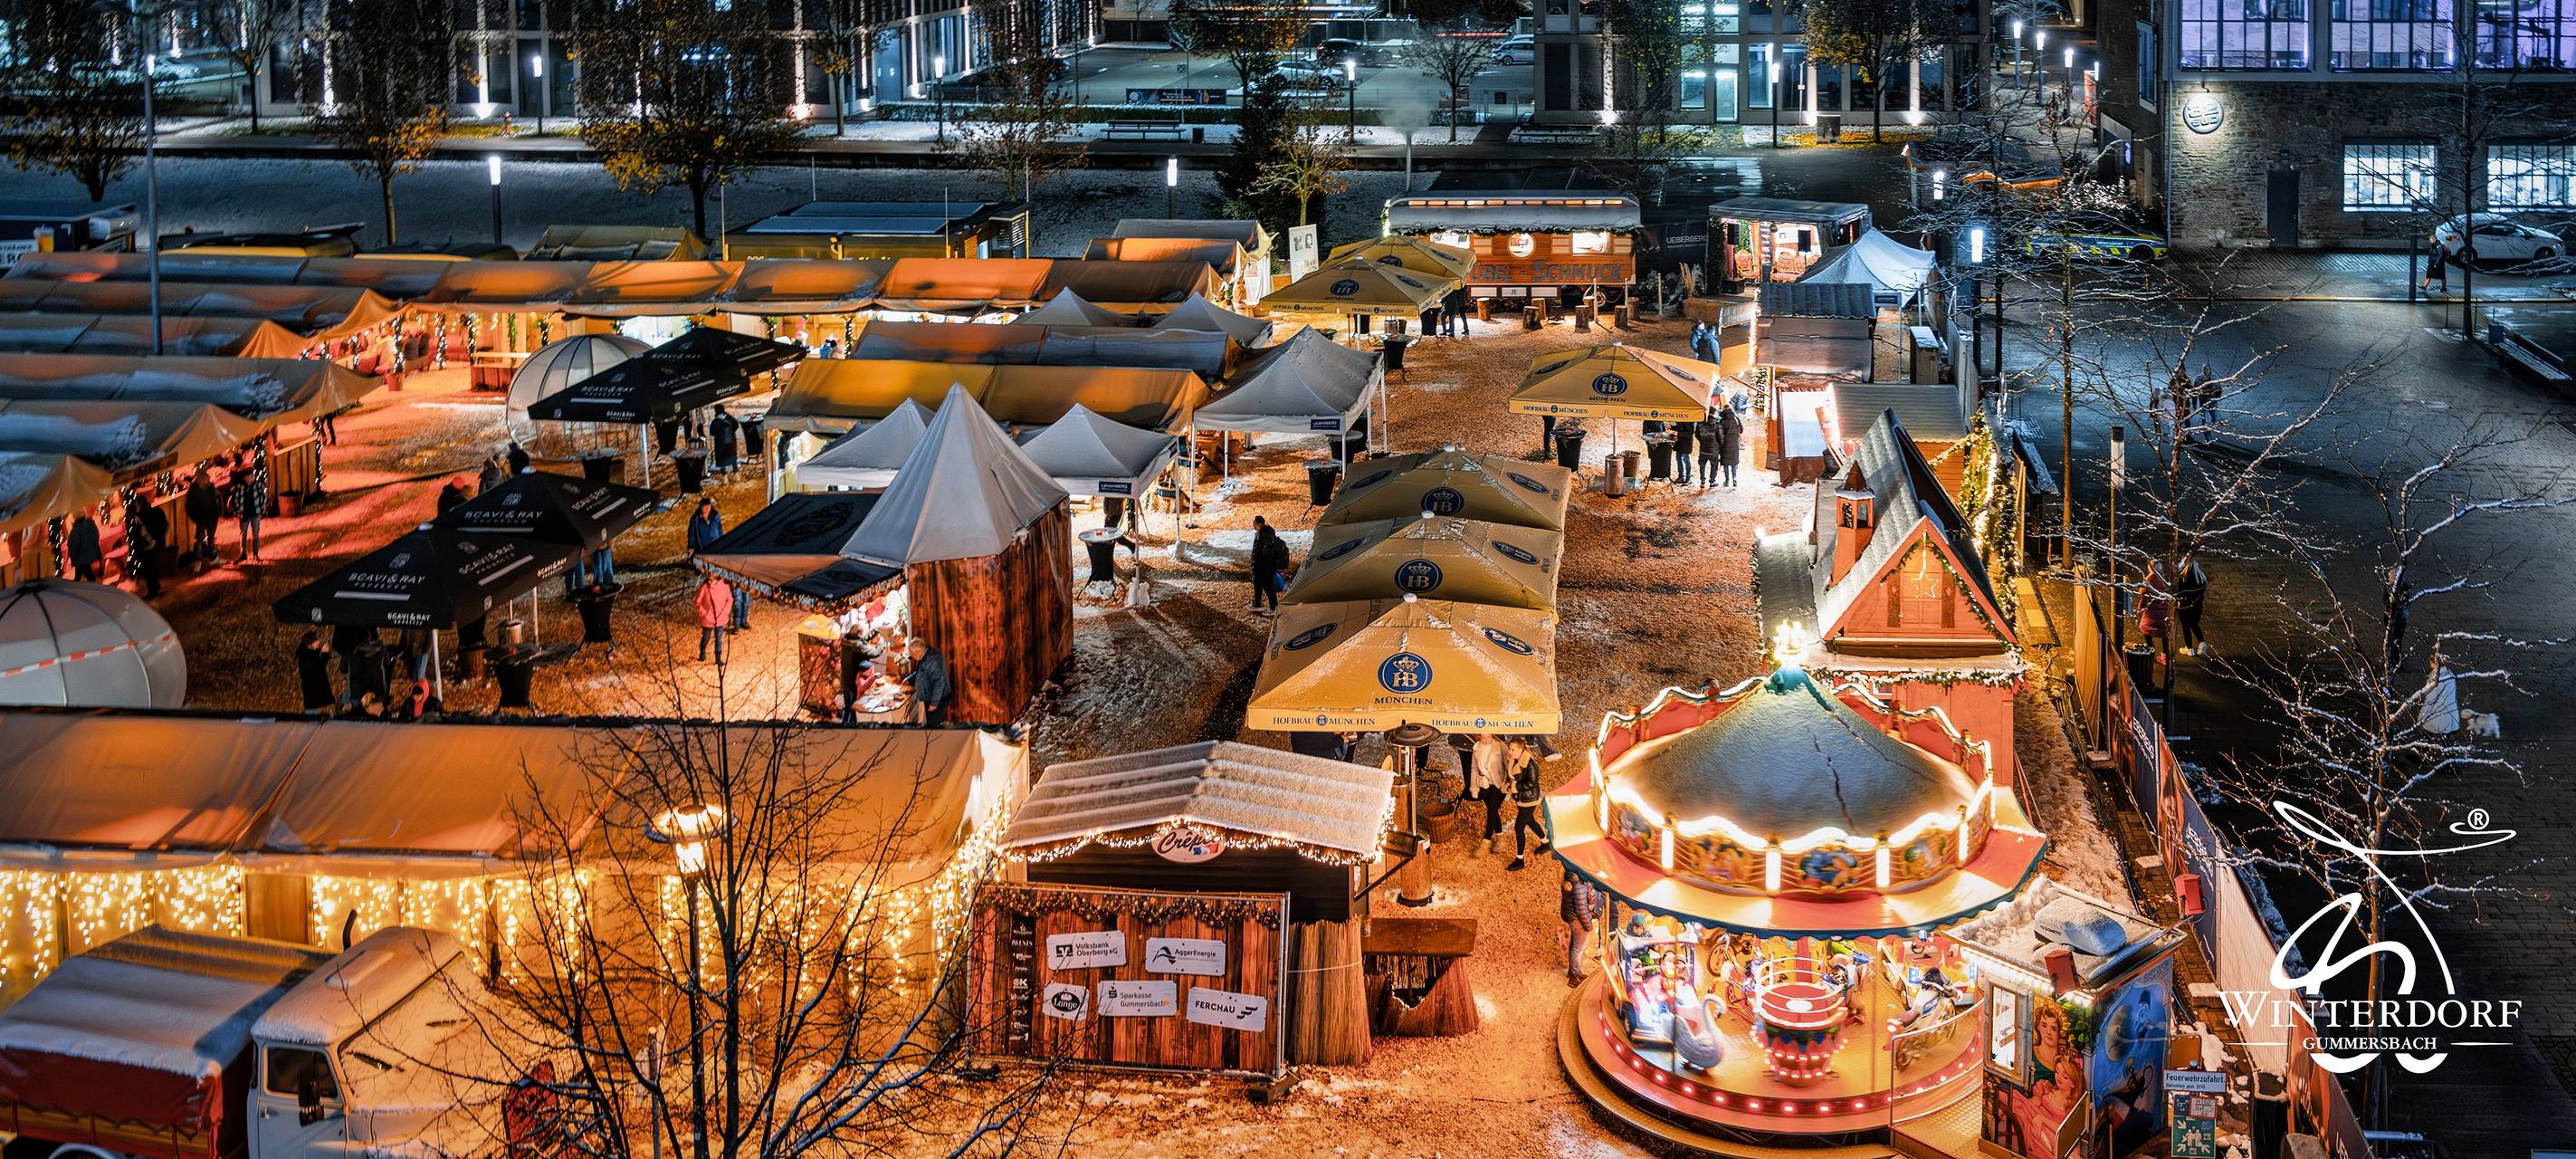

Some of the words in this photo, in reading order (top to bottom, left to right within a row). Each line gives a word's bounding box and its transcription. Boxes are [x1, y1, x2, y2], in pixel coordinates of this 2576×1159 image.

[1531, 260, 1623, 282] SCHMUCK
[1407, 575, 1430, 588] HB
[1392, 672, 1418, 687] HB
[1375, 696, 1433, 705] MÜNCHEN
[1273, 716, 1314, 724] HOFBRÄU
[1329, 716, 1376, 726] MÜNCHEN
[1487, 719, 1534, 729] MÜNCHEN
[1075, 942, 1110, 950] Volksbank
[1076, 948, 1109, 956] Oberberg
[1174, 948, 1216, 958] AggerEnergie
[1195, 1001, 1236, 1013] FERCHAU
[2166, 1073, 2224, 1084] Feuerwehrzufahrt
